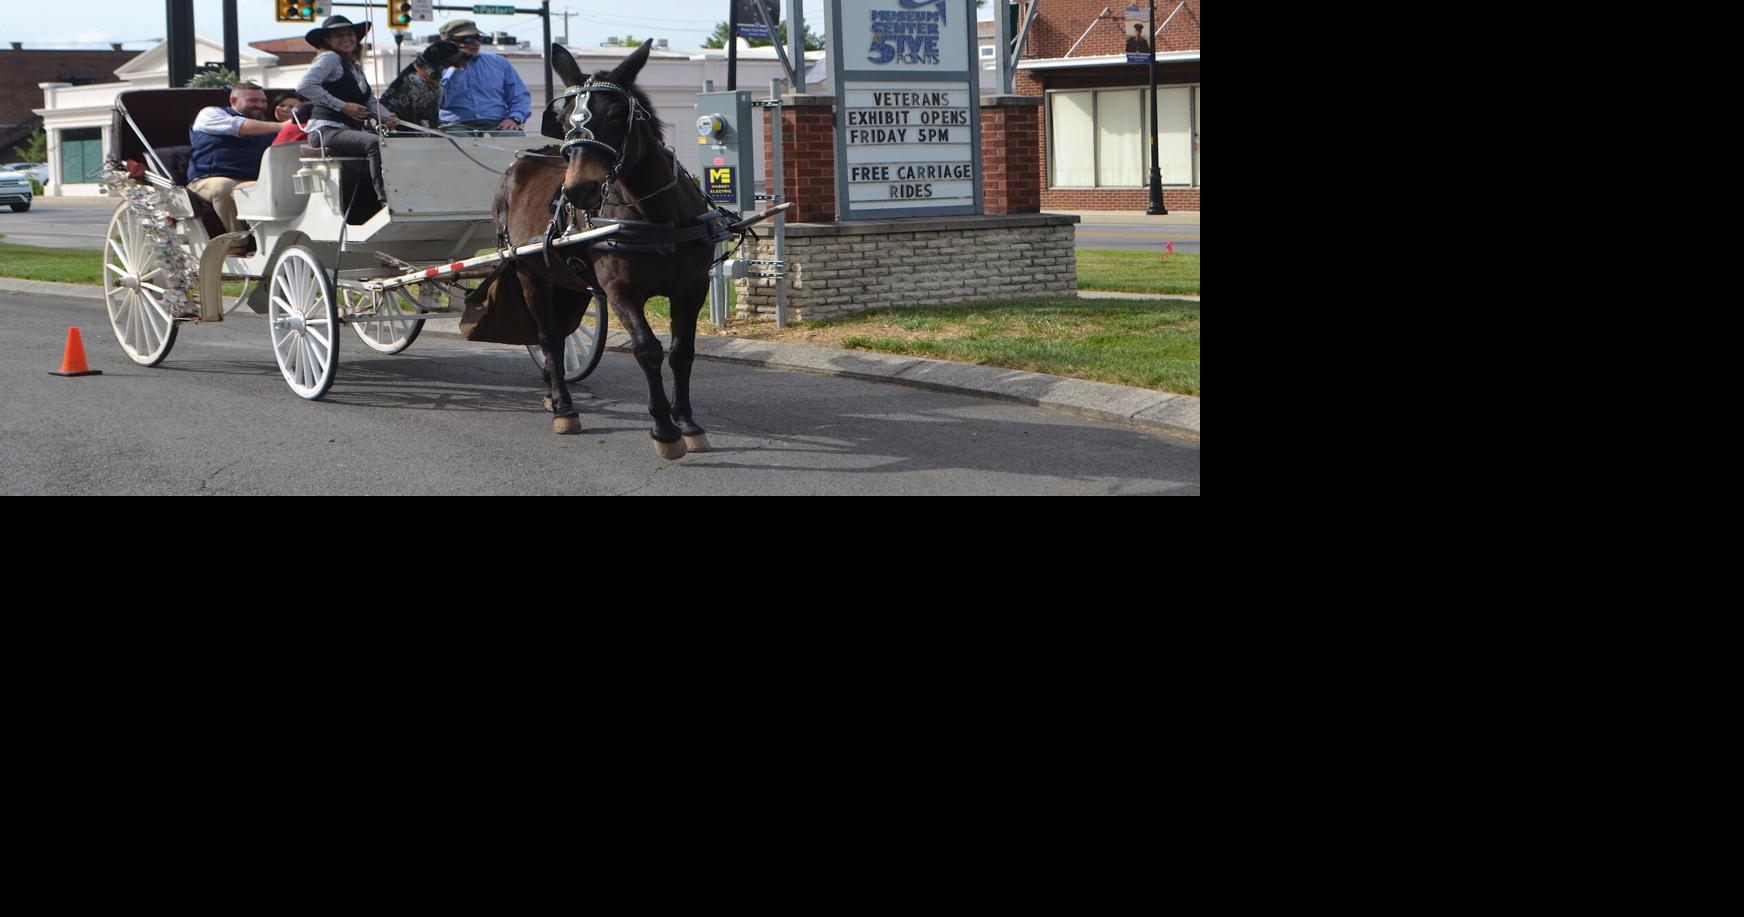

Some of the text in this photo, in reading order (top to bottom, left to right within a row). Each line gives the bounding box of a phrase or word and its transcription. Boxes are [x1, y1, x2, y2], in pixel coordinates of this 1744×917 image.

[480, 5, 508, 14] Parker
[871, 10, 939, 22] MUSEUM
[871, 22, 939, 34] CENTER
[896, 54, 940, 65] POINTS
[873, 92, 949, 107] VETERANS
[848, 110, 967, 125] EXHIBIT OPENS
[850, 128, 949, 143] FRIDAY 5PM
[709, 168, 731, 183] ME
[851, 164, 971, 181] FREE CARRIAGE
[889, 183, 933, 199] RIDES
